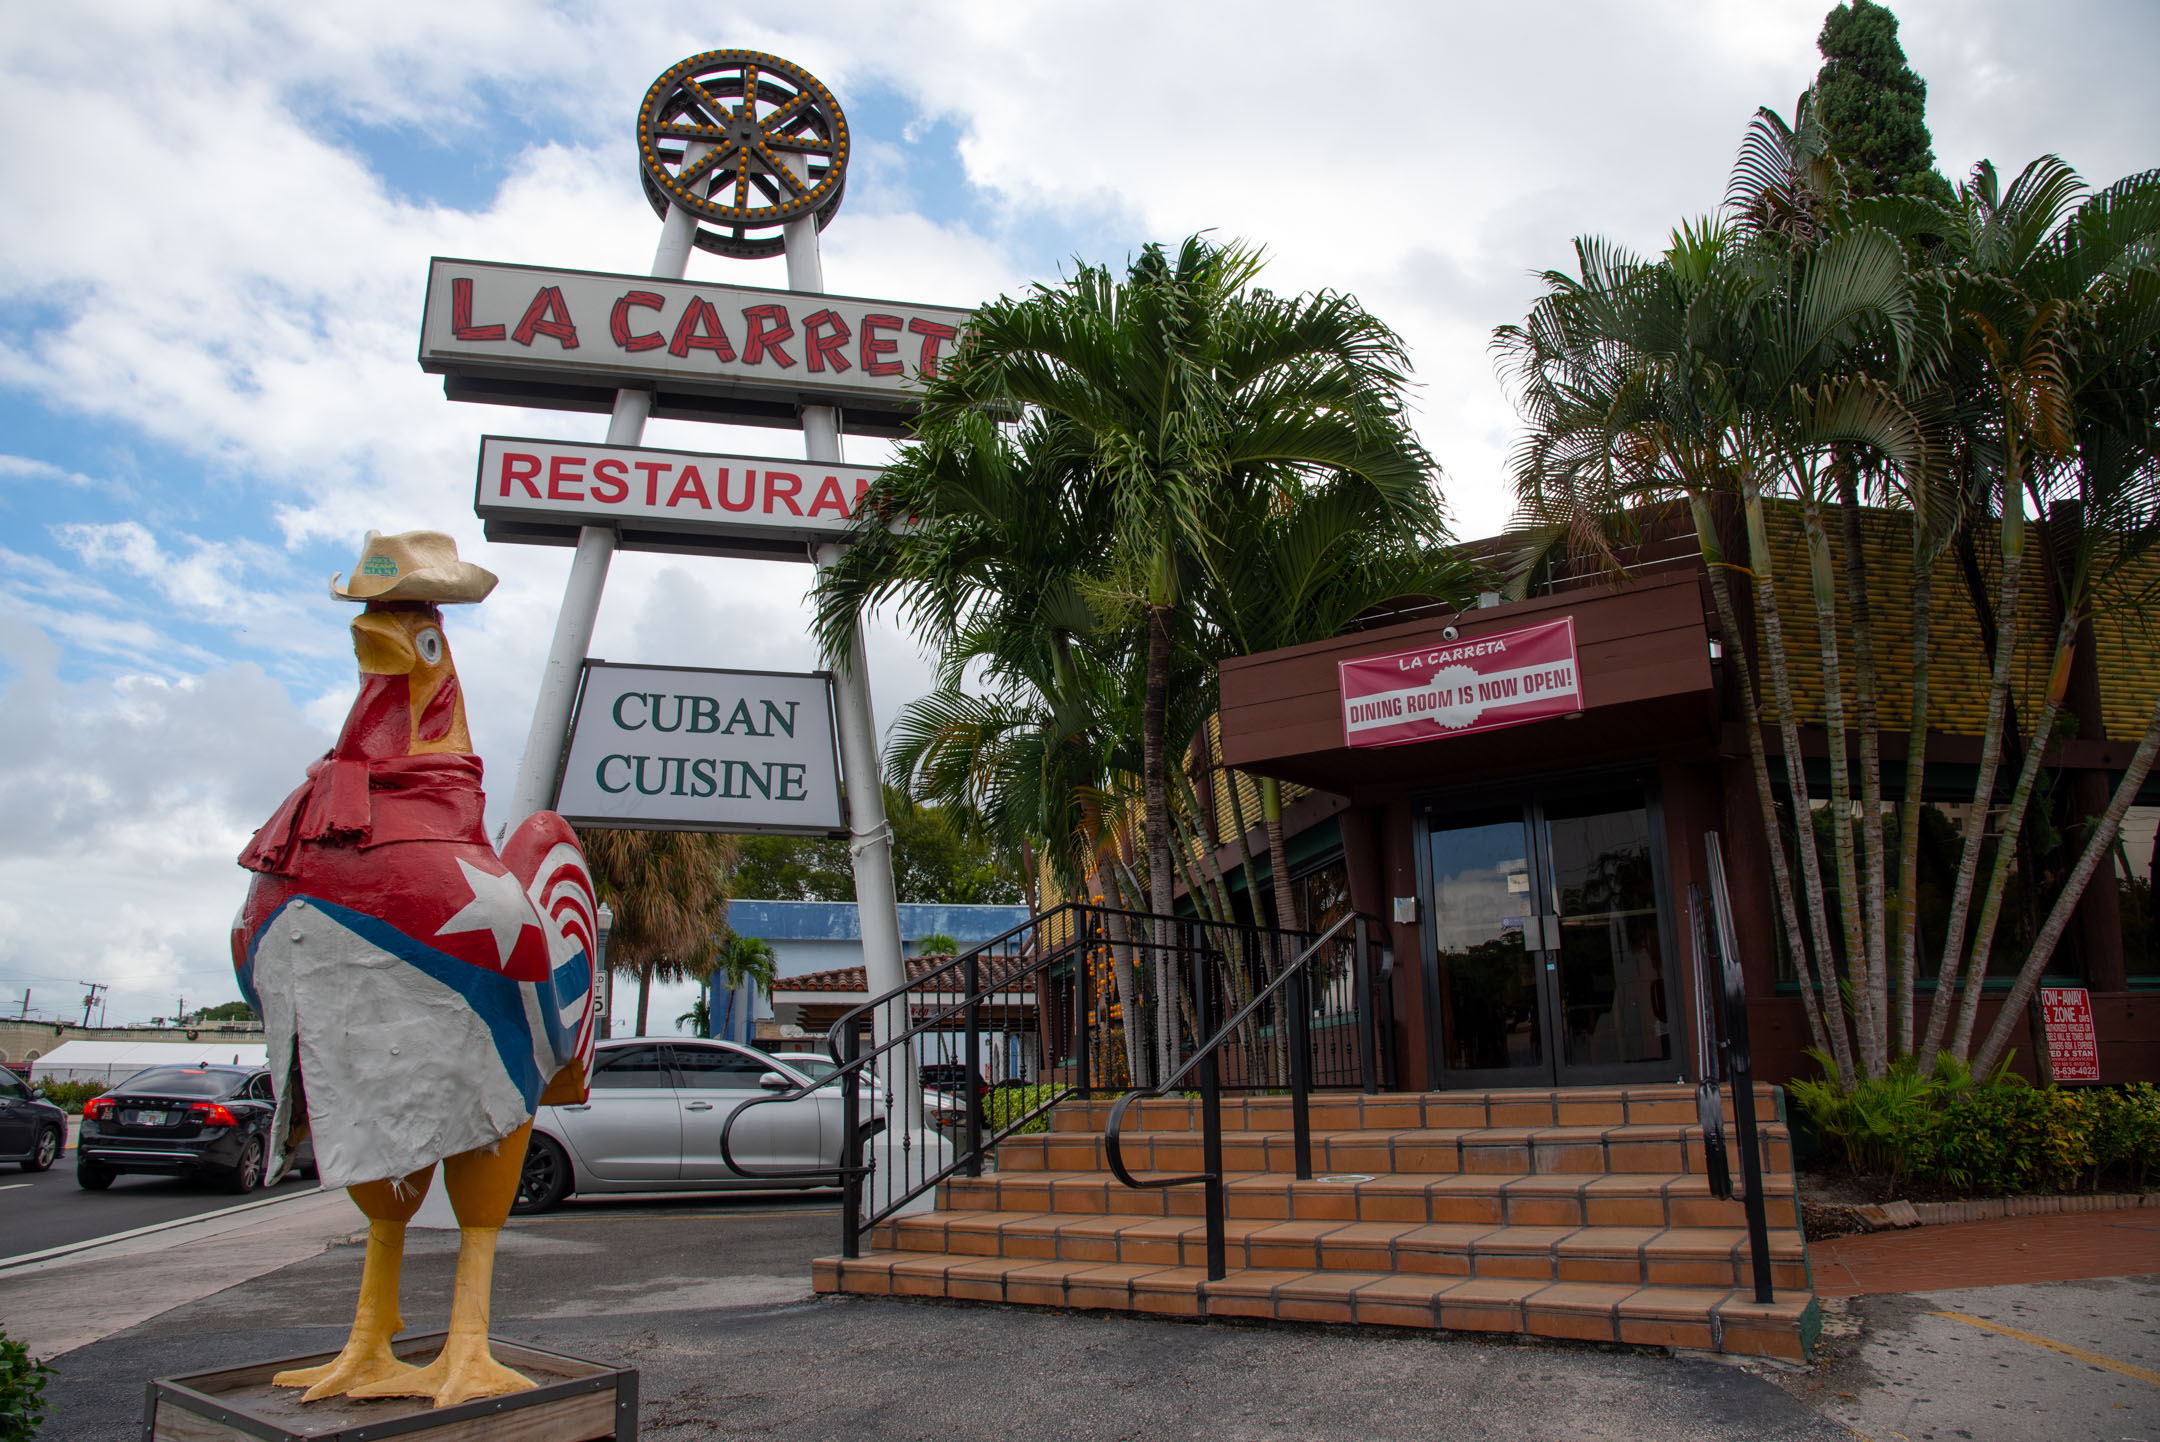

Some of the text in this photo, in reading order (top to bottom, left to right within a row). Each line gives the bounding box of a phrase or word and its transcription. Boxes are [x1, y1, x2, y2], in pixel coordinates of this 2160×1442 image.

[452, 277, 985, 382] LA CARRET
[499, 451, 905, 524] RESTAURA
[1399, 639, 1507, 671] LA CARRETA
[612, 691, 800, 739] CUBAN
[1350, 667, 1573, 724] DINING ROOM IS NOW OPEN!
[596, 753, 809, 802] CUISINE
[2045, 1023, 2067, 1032] AUTHORIZED
[2053, 1006, 2077, 1023] ZONE
[2052, 1066, 2097, 1075] 05-636-4022
